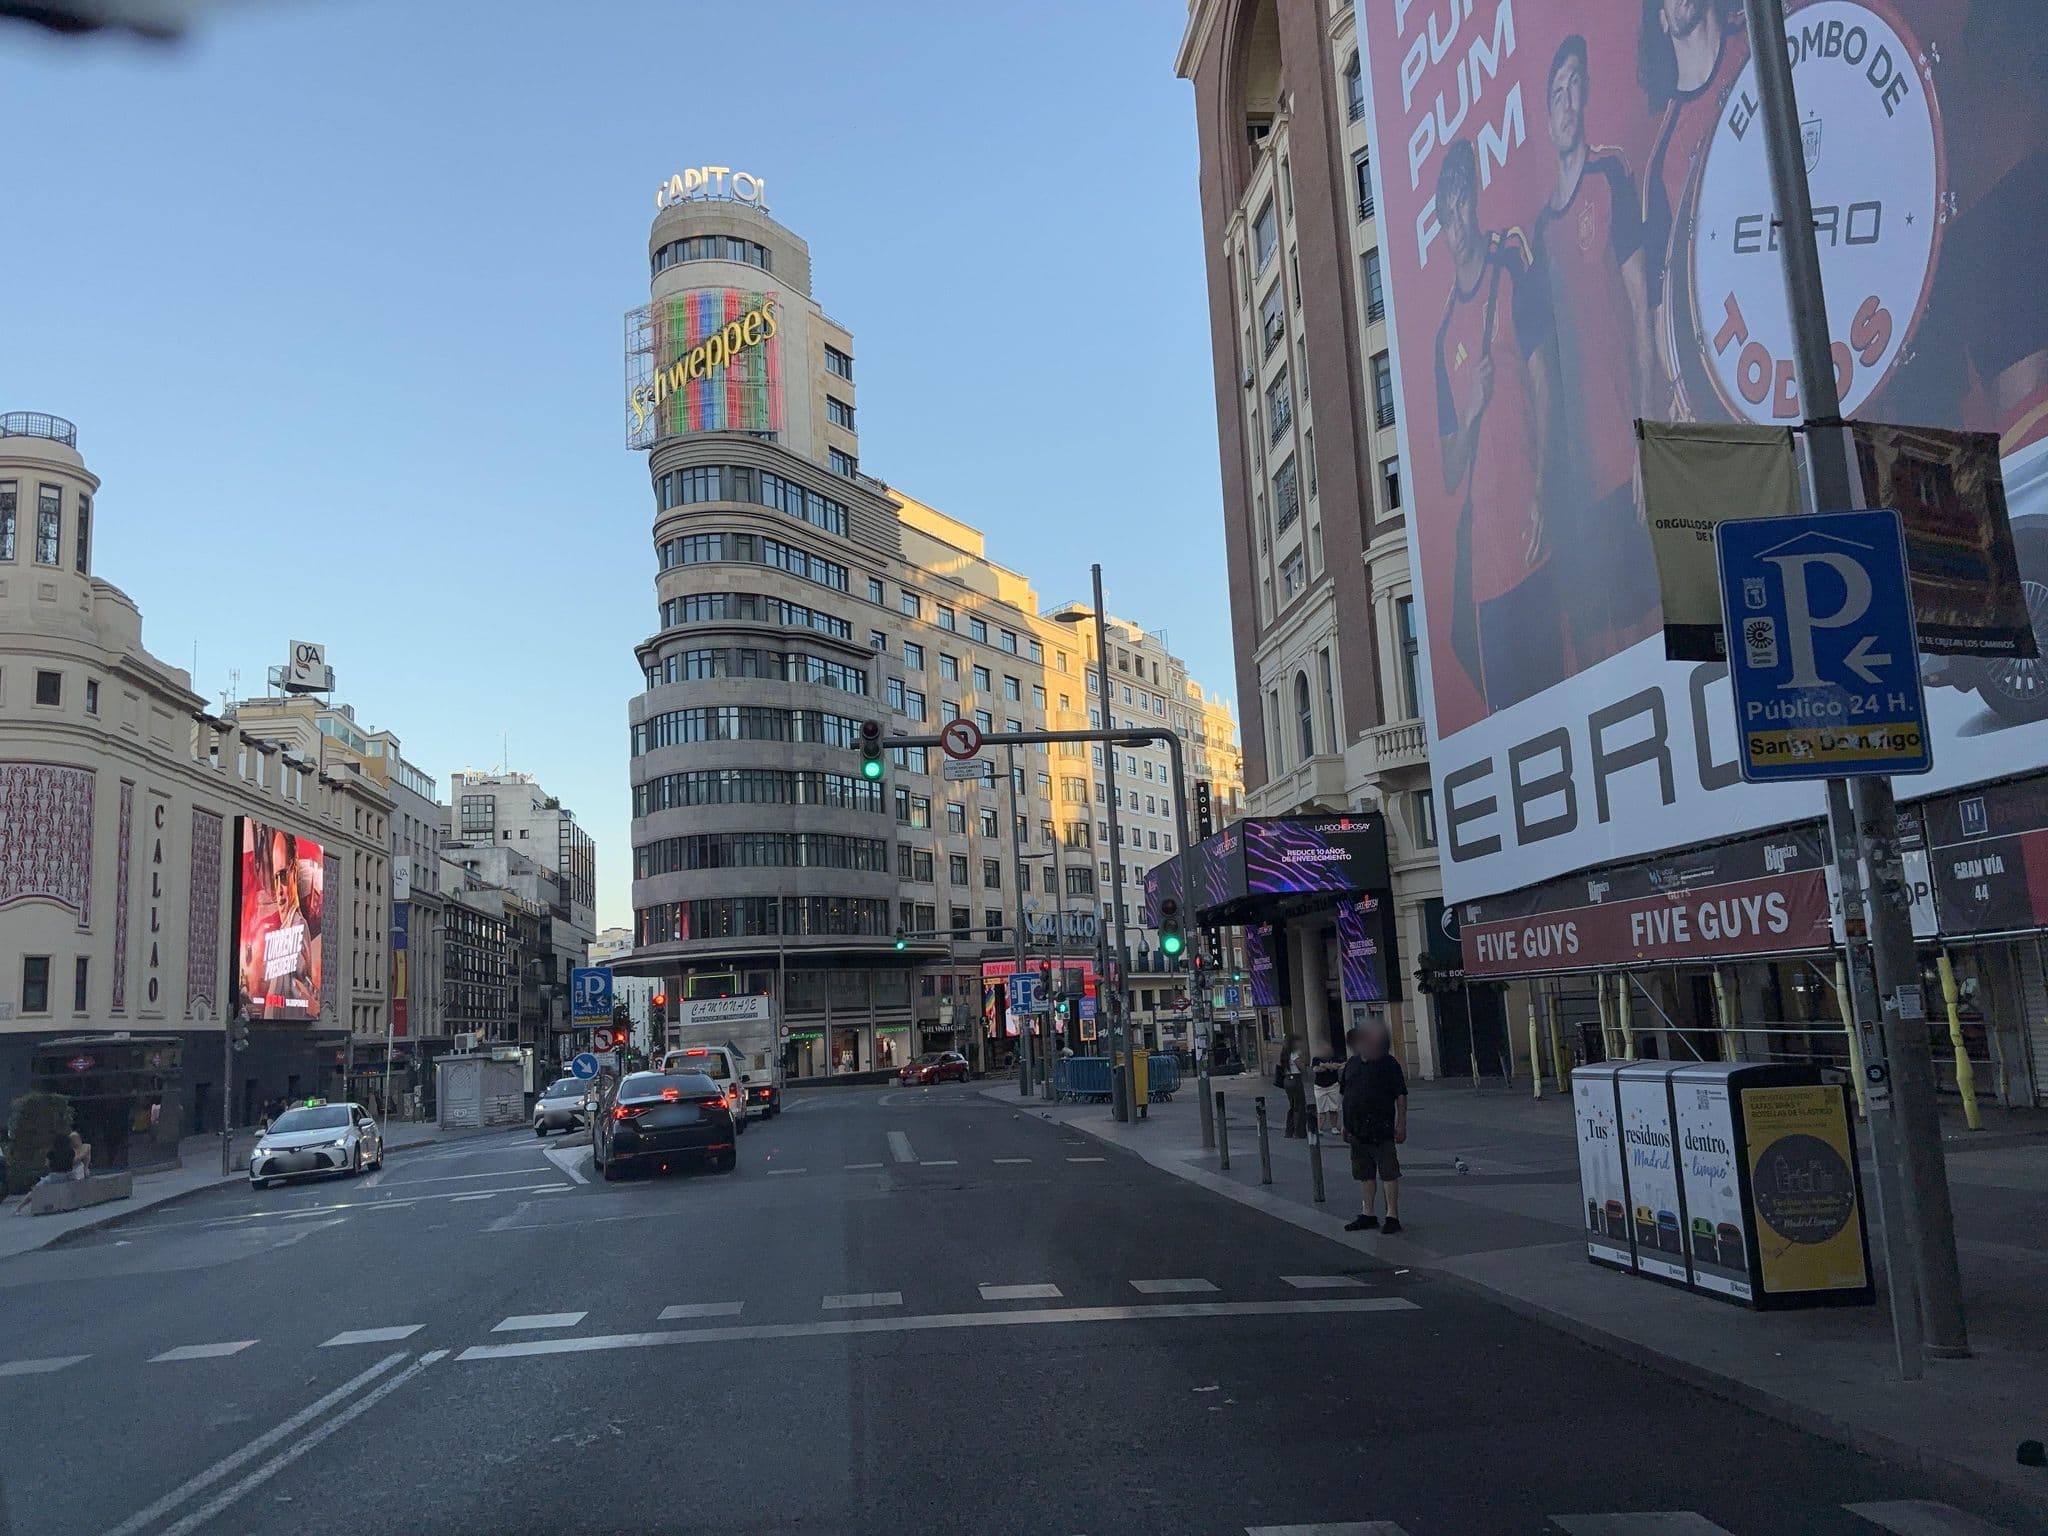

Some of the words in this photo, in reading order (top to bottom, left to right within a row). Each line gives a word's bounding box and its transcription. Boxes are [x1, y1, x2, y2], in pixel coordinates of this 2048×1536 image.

[1866, 44, 1910, 118] DE
[655, 165, 770, 213] CAPITOL
[629, 298, 778, 436] Schweppes
[1746, 697, 1842, 721] Público
[1850, 693, 1880, 714] 24
[1887, 691, 1914, 713] H.
[1199, 786, 1208, 824] ROOM
[1287, 849, 1315, 857] REDUCE
[1326, 846, 1345, 855] AÑOS
[1953, 859, 1984, 880] GRAN
[1983, 853, 2005, 875] VÍA
[148, 804, 165, 1002] CALLAO
[1974, 884, 1990, 901] 44
[1630, 906, 1691, 947] FIVE
[1698, 891, 1789, 941] GUYS
[1476, 931, 1518, 962] FIVE
[1523, 921, 1579, 958] GUYS
[1586, 1118, 1608, 1140] Tus
[1625, 1124, 1671, 1148] residuos
[1685, 1128, 1730, 1156] dentro,
[1633, 1149, 1671, 1170] Madrid
[1692, 1155, 1728, 1188] limpio
